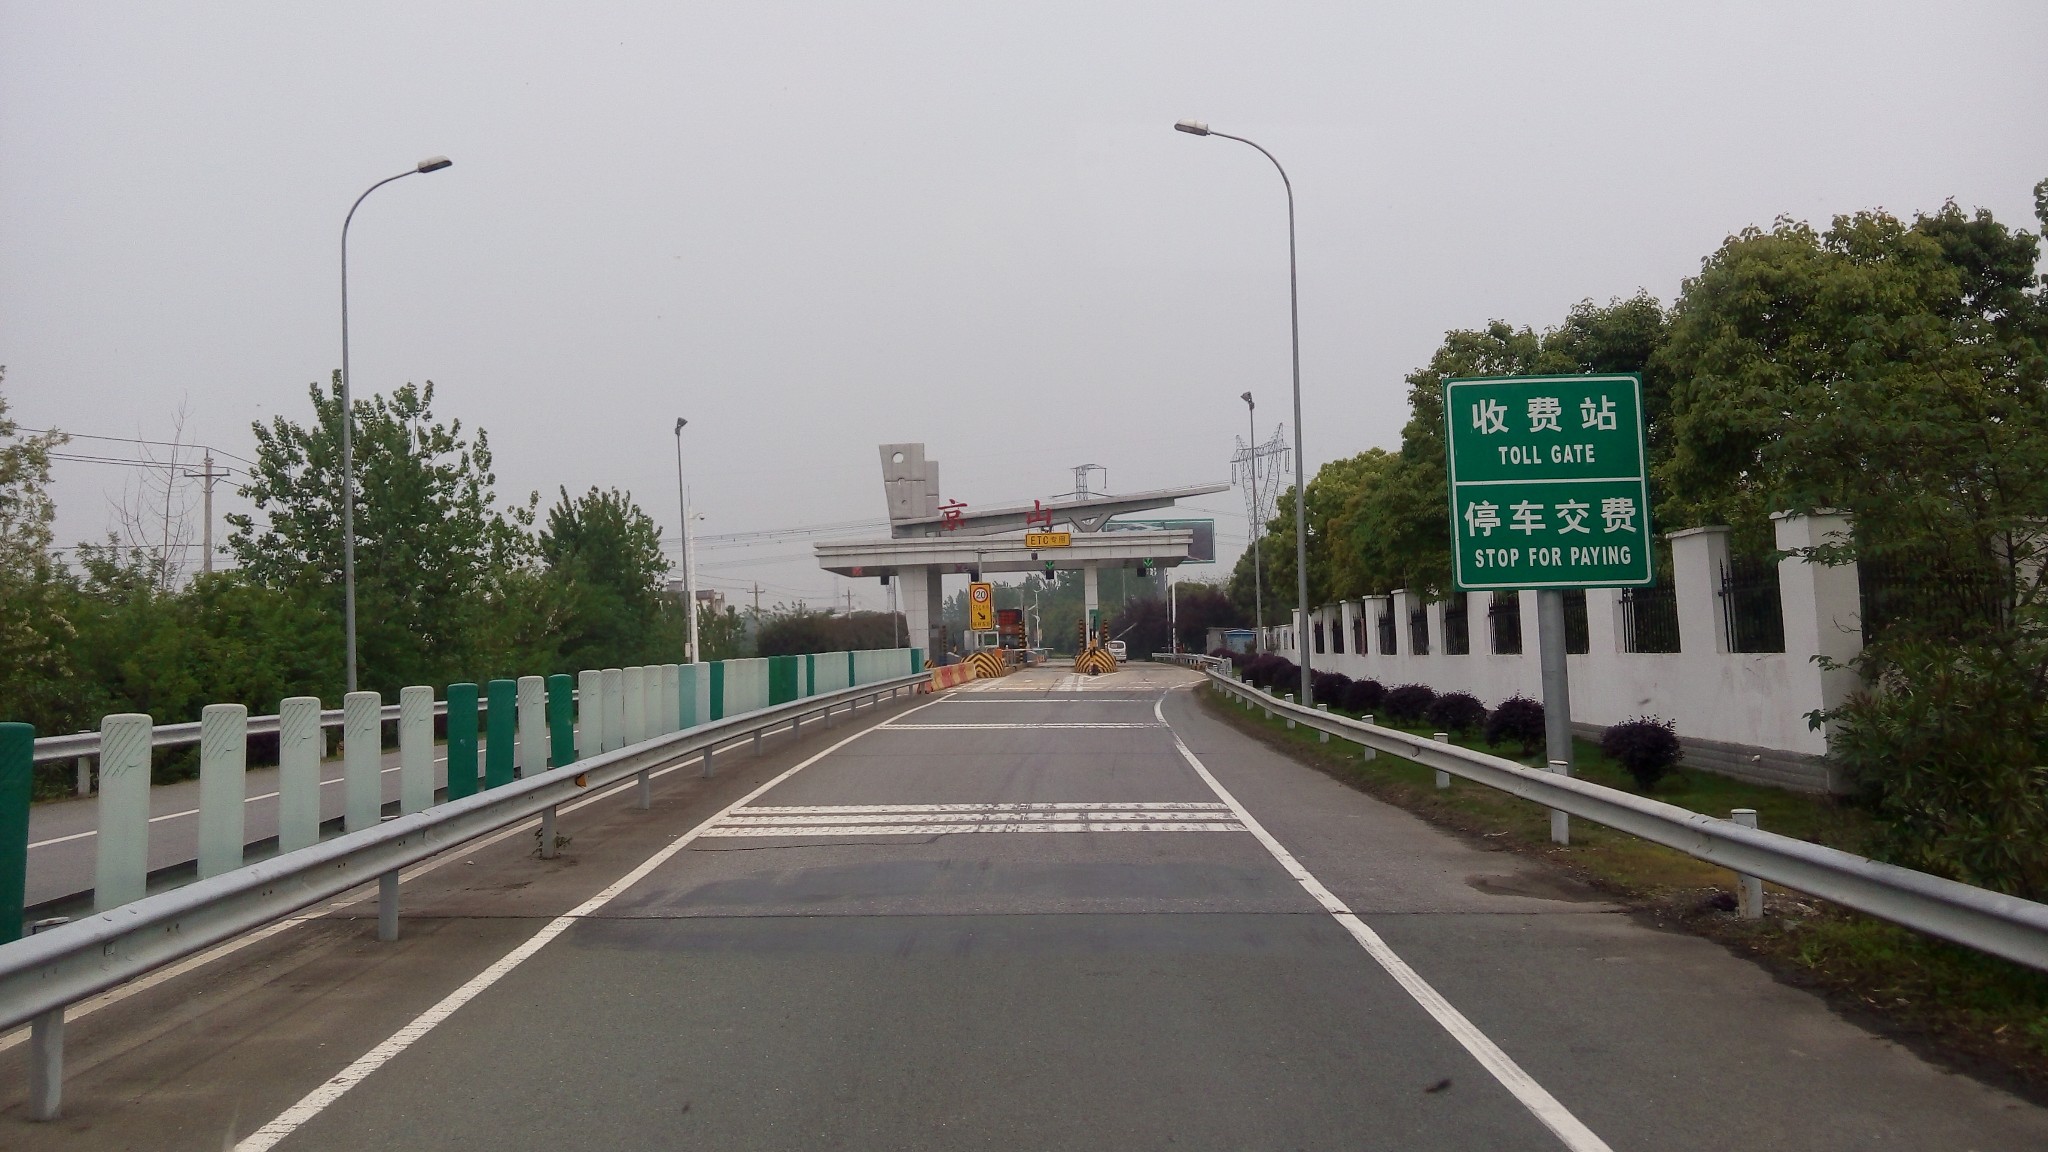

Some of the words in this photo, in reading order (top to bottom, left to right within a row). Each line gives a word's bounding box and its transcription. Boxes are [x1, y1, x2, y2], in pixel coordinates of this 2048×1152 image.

[1471, 394, 1617, 435] 收费站
[1498, 445, 1542, 465] TOLL
[1551, 443, 1595, 464] GATE
[1464, 497, 1637, 537] 停车交费
[1475, 548, 1520, 568] STOP
[1528, 547, 1562, 567] FOR
[1570, 545, 1631, 566] PAYING
[976, 590, 986, 599] 20
